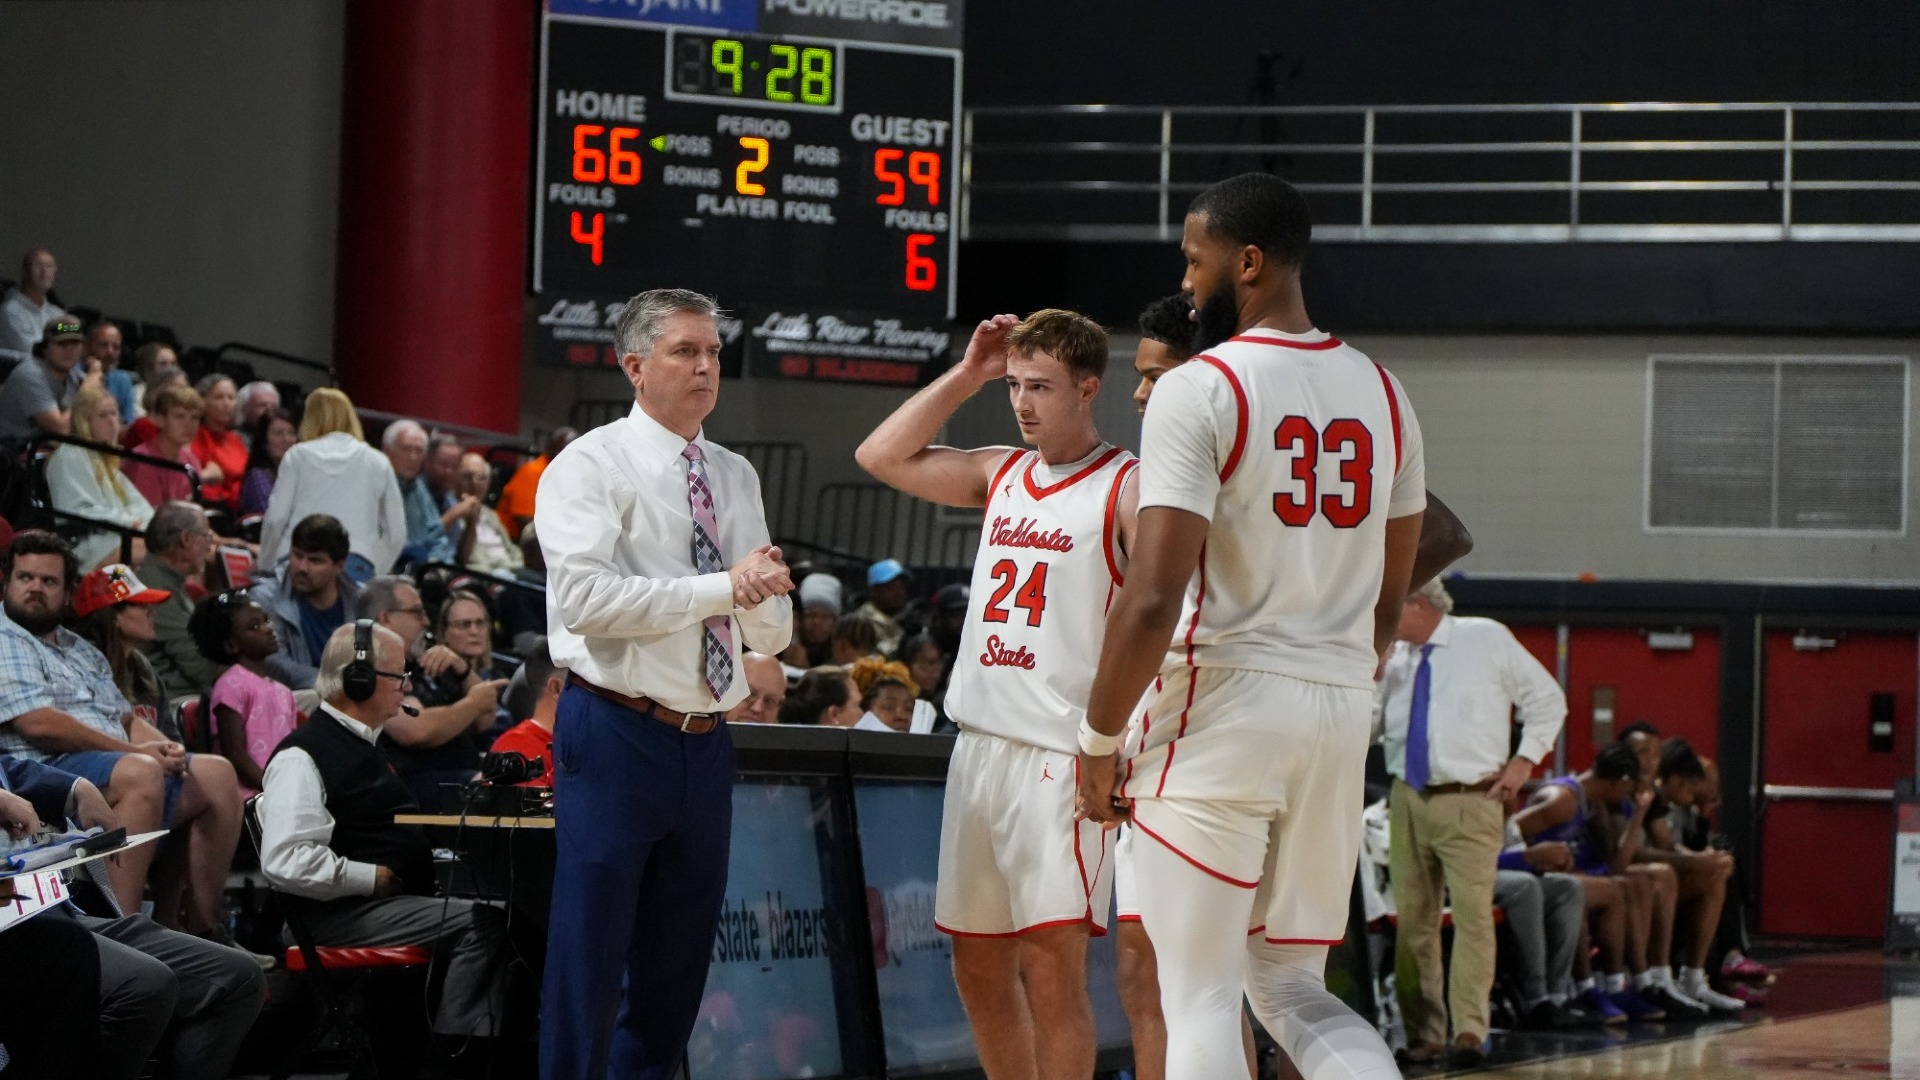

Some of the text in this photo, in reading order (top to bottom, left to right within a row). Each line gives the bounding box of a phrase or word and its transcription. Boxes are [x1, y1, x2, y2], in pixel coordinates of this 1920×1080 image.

[556, 89, 647, 122] HOME
[717, 114, 791, 140] PERIOD
[851, 113, 949, 146] GUEST
[572, 124, 642, 186] 66
[735, 136, 770, 196] 2
[794, 144, 841, 167] POSS
[663, 164, 722, 188] BONUS
[782, 174, 840, 197] BONUS
[874, 148, 941, 206] 59
[549, 183, 616, 208] FOULS
[696, 194, 838, 225] PLAYER FOUL
[885, 208, 949, 232] FOULS
[570, 211, 605, 267] 4
[905, 233, 937, 292] 6
[752, 312, 812, 341] Little
[815, 315, 871, 344] River
[873, 319, 950, 358] Flooring
[1273, 415, 1374, 529] 33
[989, 515, 1074, 553] Valdosta
[983, 558, 1049, 628] 24
[980, 634, 1036, 671] State
